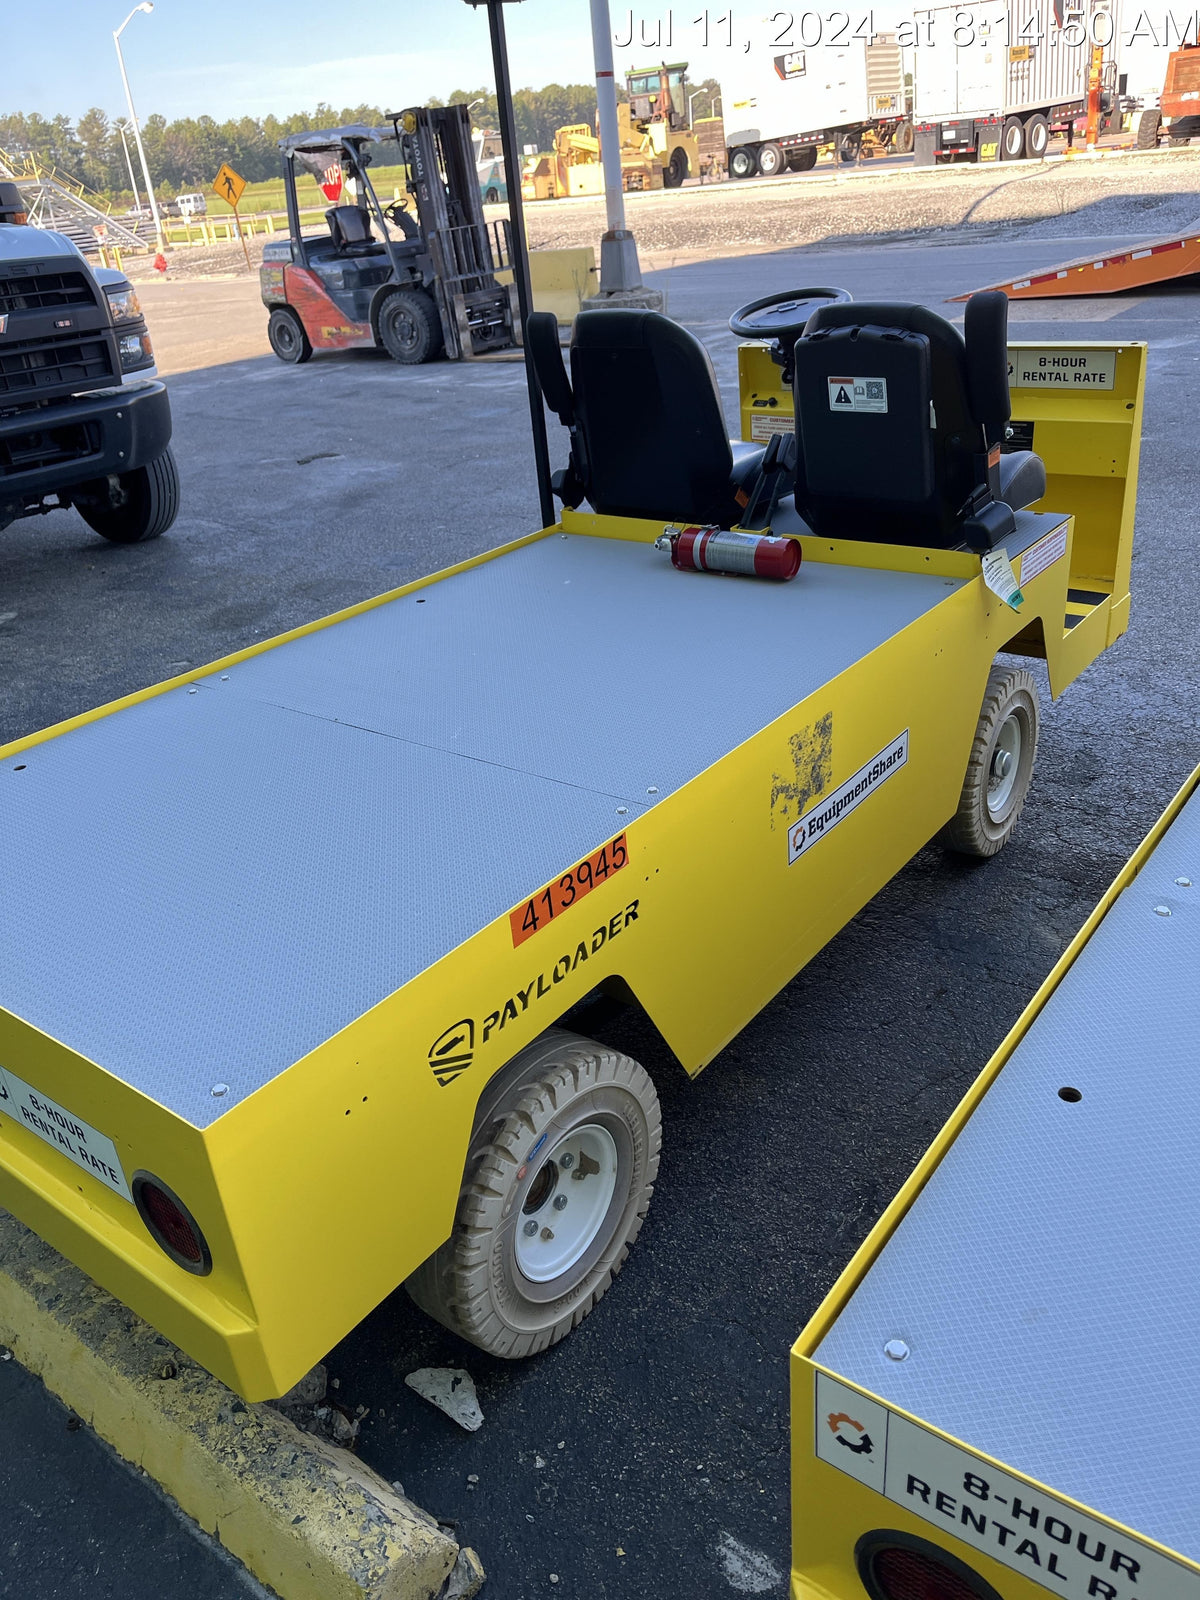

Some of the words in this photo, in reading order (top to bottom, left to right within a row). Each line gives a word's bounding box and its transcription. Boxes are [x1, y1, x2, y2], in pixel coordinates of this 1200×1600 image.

[784, 51, 805, 73] CAT
[411, 135, 424, 177] TOYOTA
[980, 142, 998, 157] CAT
[1023, 371, 1069, 382] RENTAL
[1073, 373, 1106, 383] RATE
[1039, 357, 1087, 368] 8-HOUR
[808, 745, 903, 838] EquipmentShare
[522, 835, 626, 931] 413945
[482, 898, 640, 1044] PAYLOADER
[20, 1105, 76, 1154] RENTAL
[78, 1145, 119, 1185] RATE
[29, 1093, 87, 1144] 8-HOUR
[906, 1474, 1067, 1581] RENTAL
[962, 1471, 1142, 1584] 8-HOUR
